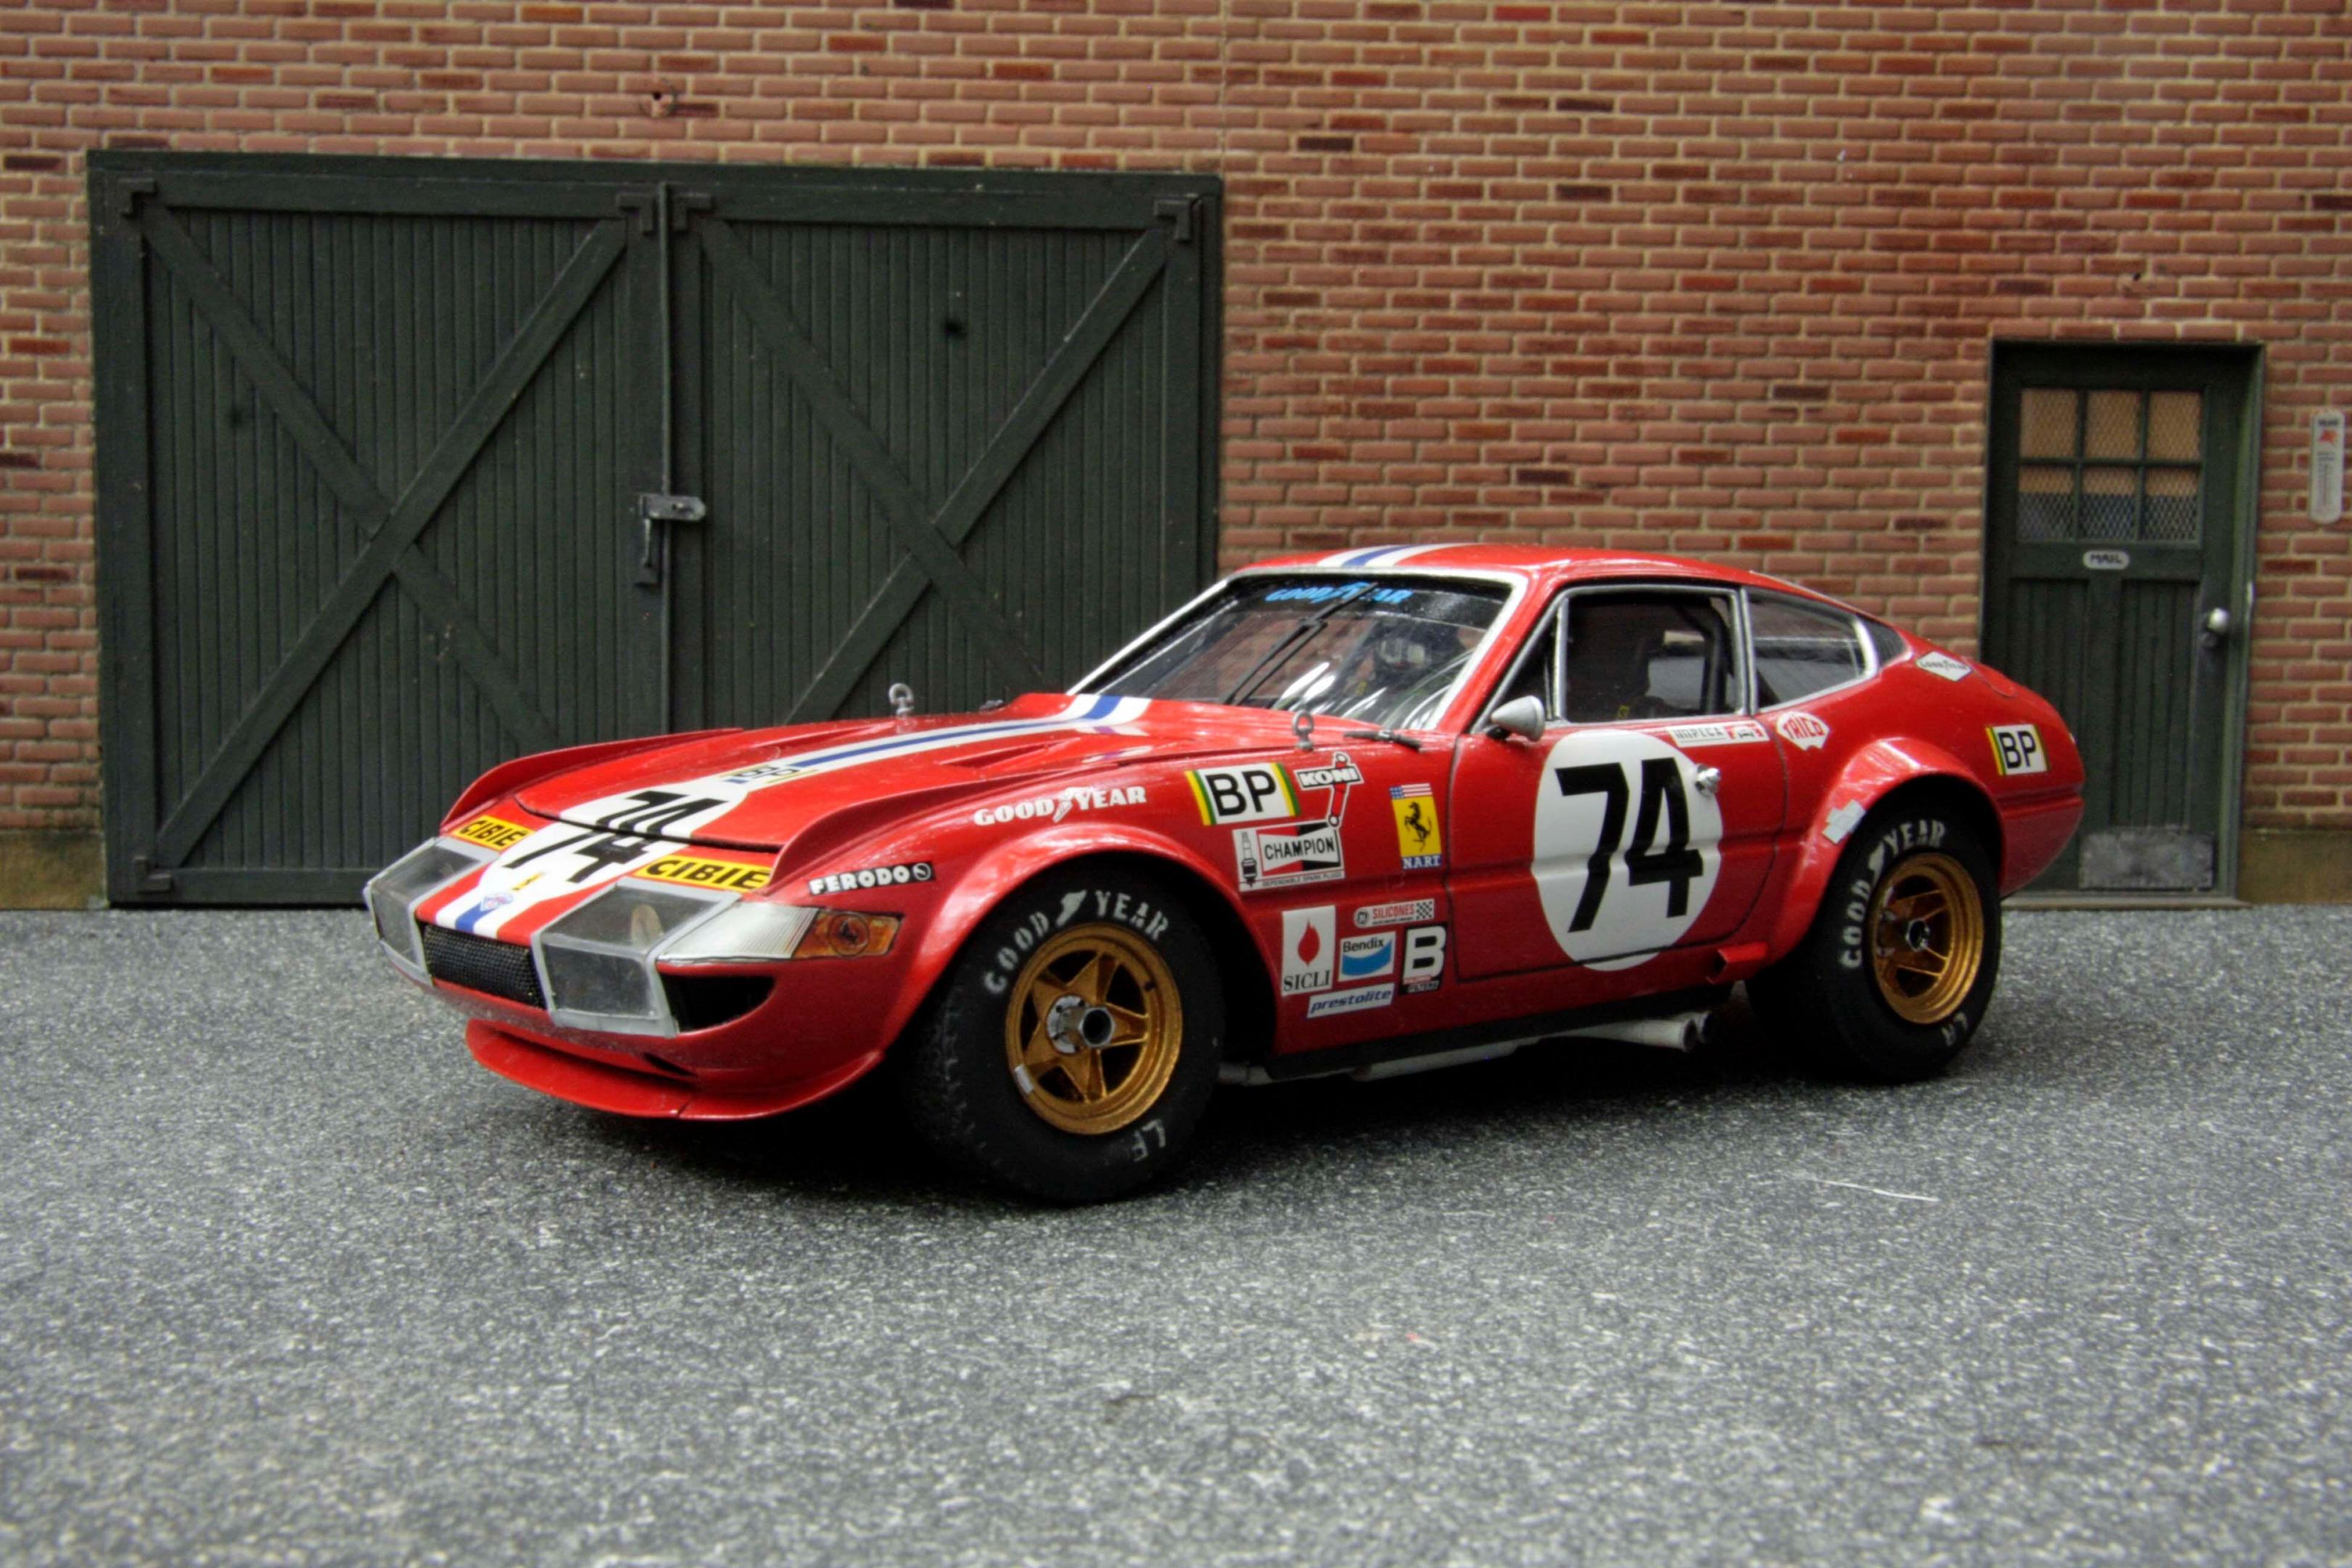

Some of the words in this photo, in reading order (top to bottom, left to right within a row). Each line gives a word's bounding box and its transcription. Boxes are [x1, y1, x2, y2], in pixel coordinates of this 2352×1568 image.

[2089, 553, 2123, 565] MAIL
[1998, 730, 2037, 769] BP
[1298, 767, 1360, 787] KONI
[1205, 769, 1277, 817] BP
[458, 820, 526, 848] CIBIE
[503, 790, 729, 883] 74
[1555, 756, 1704, 934] 74
[1265, 836, 1335, 860] CHAMPION
[645, 859, 769, 889] CIBIE
[1402, 855, 1441, 870] NART
[809, 866, 910, 895] FERODO
[1372, 903, 1415, 919] SILICONES
[1343, 937, 1384, 953] Bendix
[1283, 969, 1331, 992] SICLI
[1310, 987, 1392, 1014] prestolite
